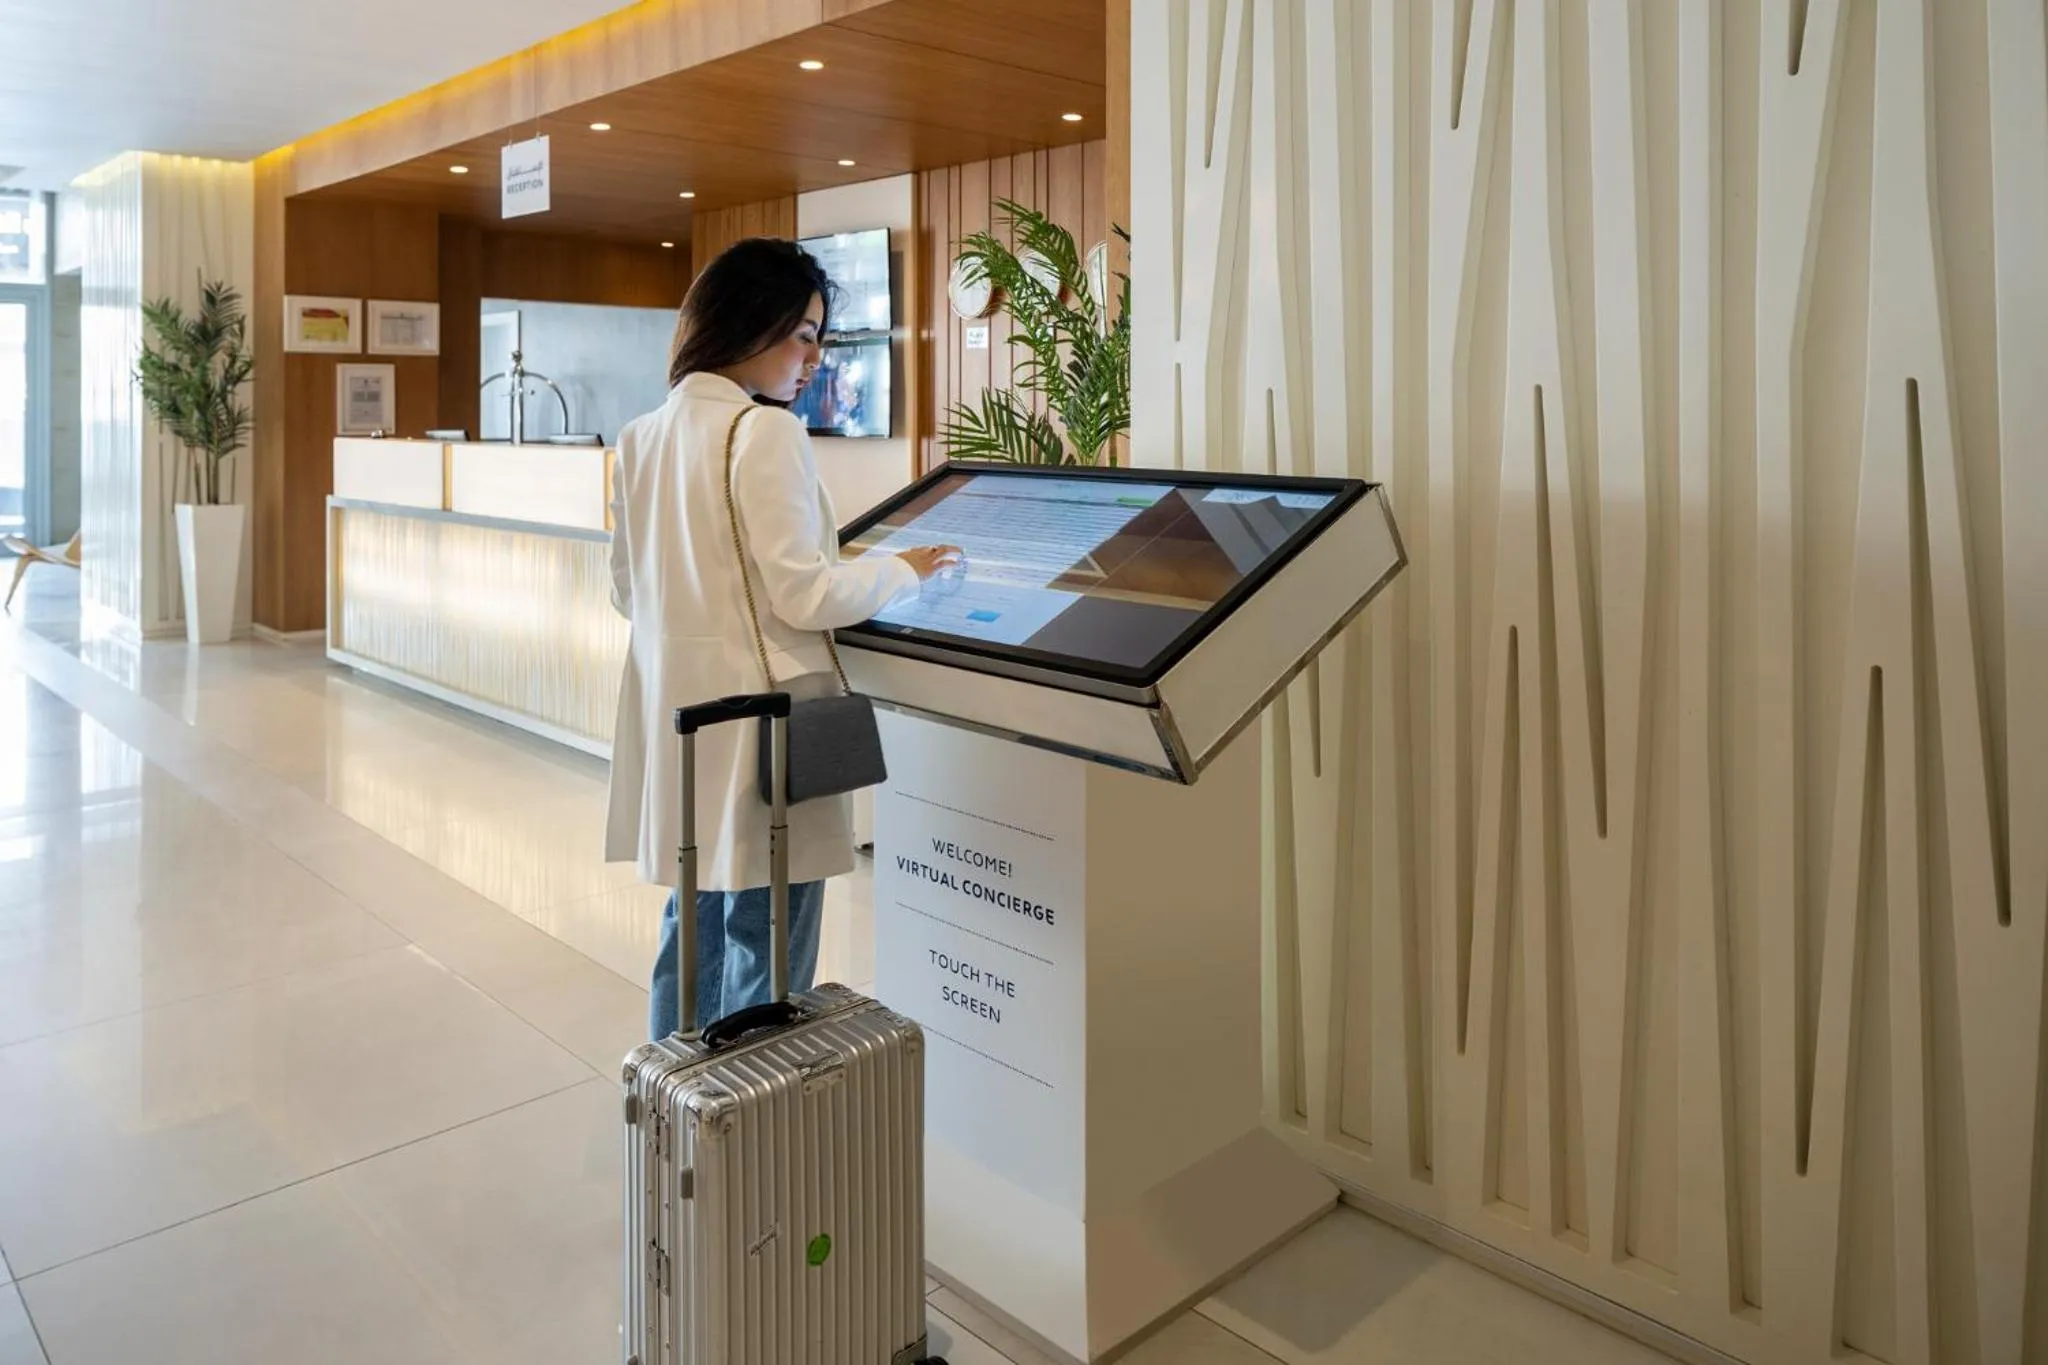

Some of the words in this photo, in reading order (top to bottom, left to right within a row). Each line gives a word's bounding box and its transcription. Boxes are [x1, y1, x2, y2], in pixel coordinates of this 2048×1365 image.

[931, 837, 1013, 877] WELCOME!
[896, 855, 959, 891] VIRTUAL
[962, 880, 1055, 925] CONCIERGE
[929, 949, 980, 983] TOUCH
[984, 972, 1016, 998] THE
[942, 986, 1001, 1023] SCREEN
